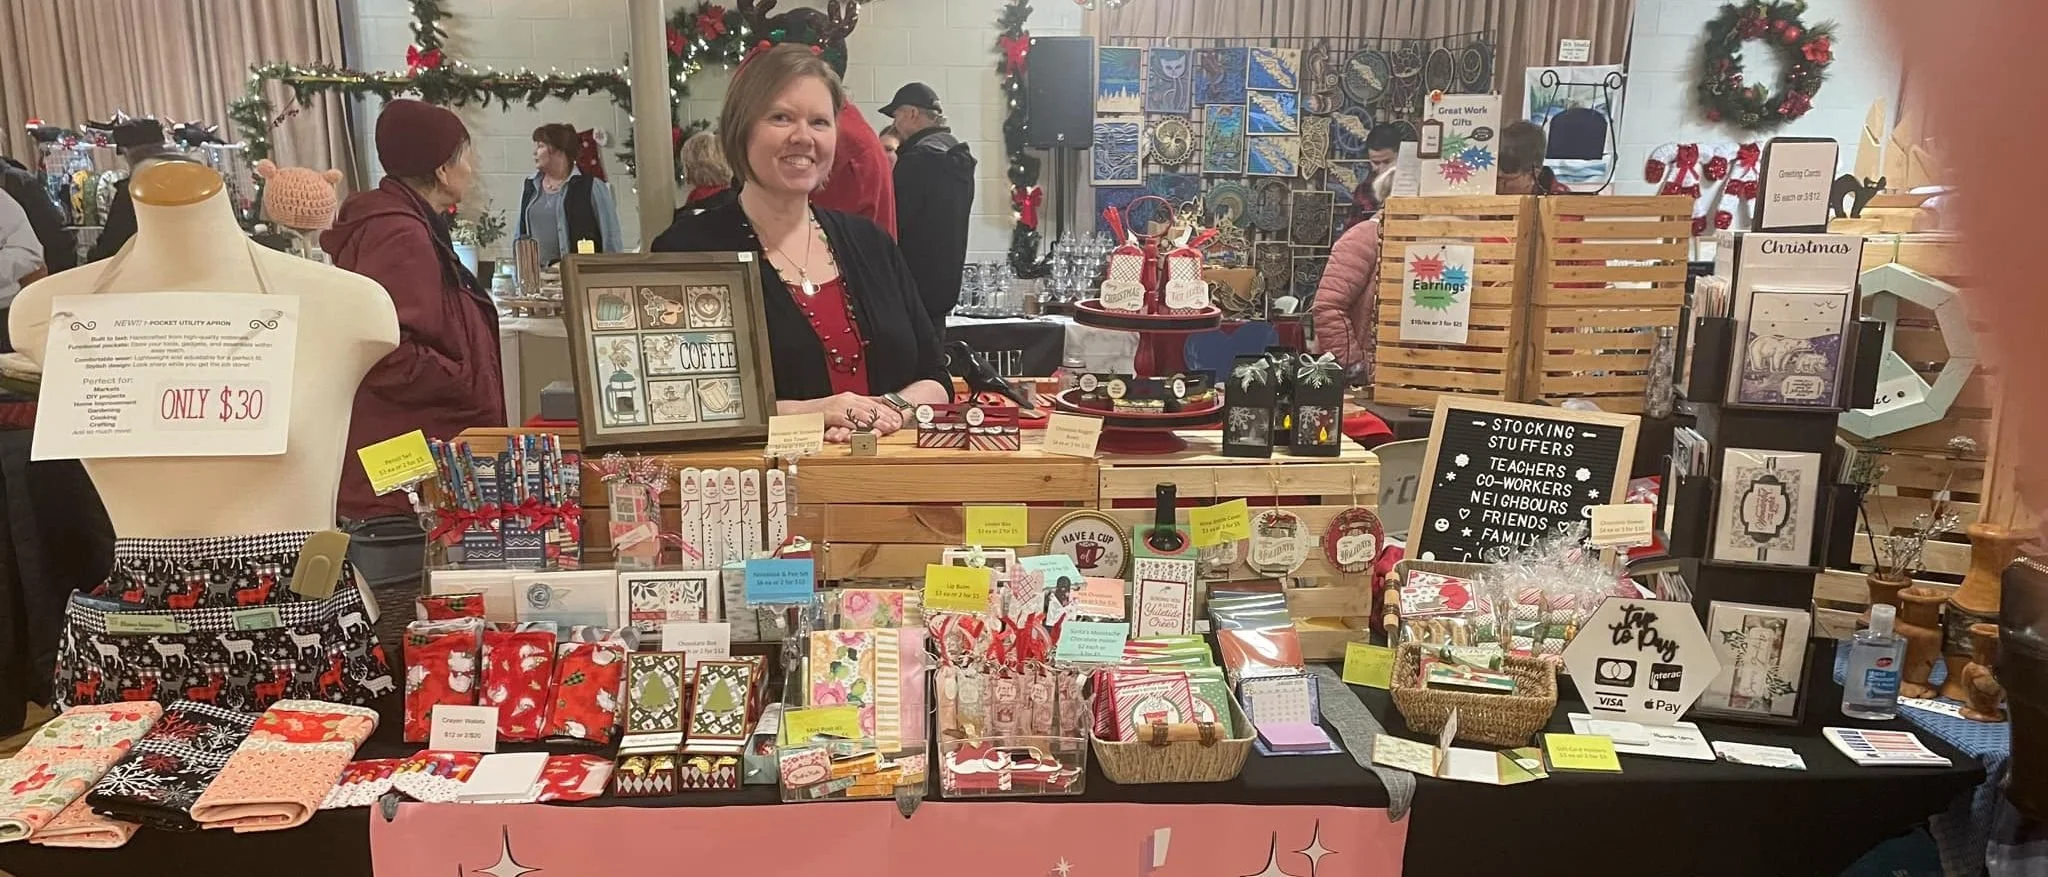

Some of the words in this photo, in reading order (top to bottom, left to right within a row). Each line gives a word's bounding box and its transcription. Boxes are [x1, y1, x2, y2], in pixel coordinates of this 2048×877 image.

[1438, 106, 1462, 114] Great
[1464, 106, 1488, 114] Work
[1452, 118, 1472, 126] Gifts
[1760, 238, 1852, 254] Christmas
[1104, 287, 1140, 302] CHRISTMAS
[1413, 279, 1466, 294] Earrings
[679, 342, 737, 370] COFFEE
[161, 388, 210, 420] ONLY
[219, 386, 264, 422] $30
[1492, 418, 1575, 439] STOCKING
[1488, 436, 1574, 457] STUFFERS
[1490, 457, 1567, 479] TEACHERS
[1476, 474, 1572, 497] CO-WORKERS
[1470, 490, 1568, 515] NEIGHBOURS
[1481, 510, 1548, 530] FRIENDS
[1061, 532, 1086, 544] HAVE
[1089, 532, 1094, 540] A
[1097, 533, 1114, 544] CUP
[1481, 528, 1540, 547] FAMILY
[1080, 549, 1092, 563] of
[1144, 602, 1182, 617] Yuletide
[1149, 617, 1178, 628] Cheer
[1608, 622, 1634, 645] to
[1638, 628, 1680, 662] Pay
[1600, 697, 1624, 706] VISA
[1656, 700, 1681, 714] Pay
